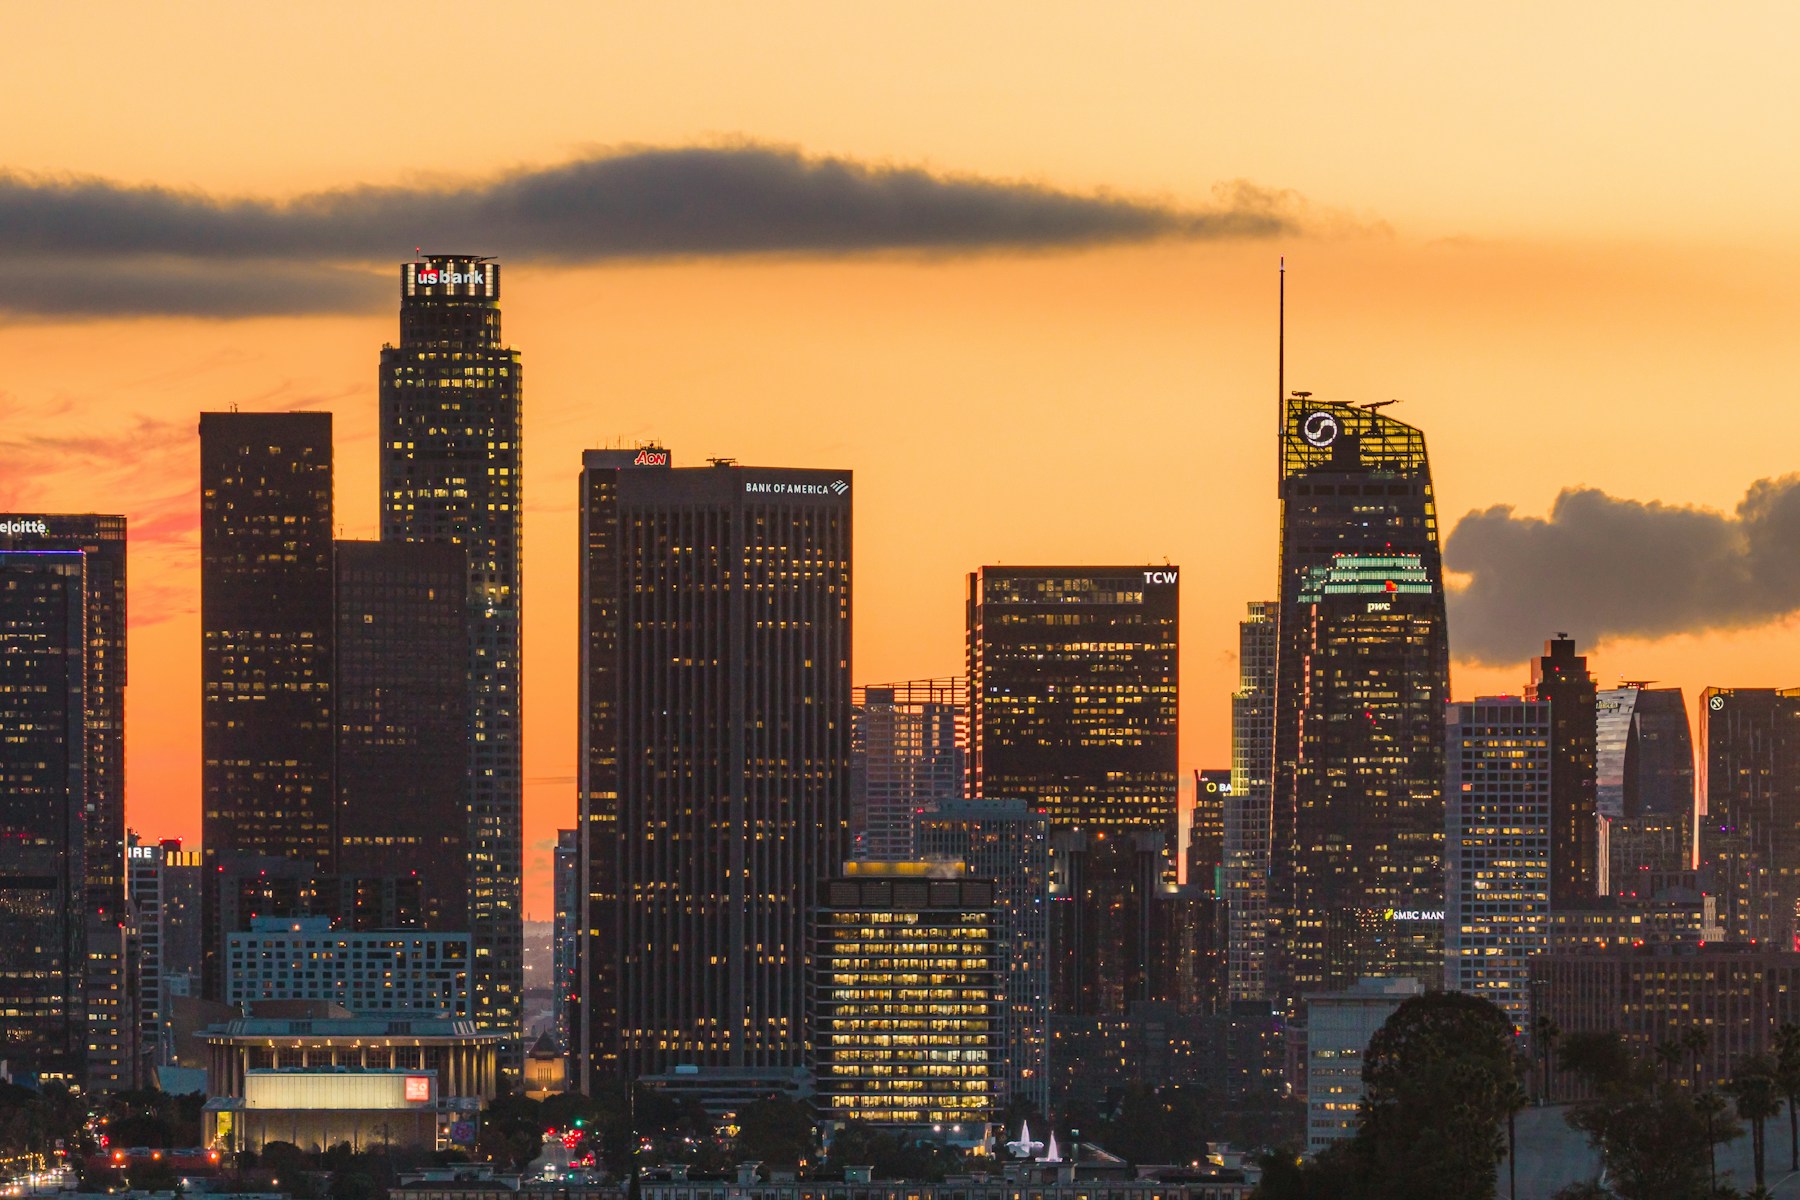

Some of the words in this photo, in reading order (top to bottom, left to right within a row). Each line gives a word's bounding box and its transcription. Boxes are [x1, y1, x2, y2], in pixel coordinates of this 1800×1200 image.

[634, 450, 666, 465] AON
[745, 482, 772, 493] BANK
[773, 483, 786, 493] OF
[787, 484, 829, 495] AMERICA
[1143, 571, 1178, 584] TCW
[1367, 602, 1391, 613] pwc
[128, 847, 152, 858] IRE
[1393, 910, 1419, 920] SMBC
[1421, 911, 1445, 920] MAN
